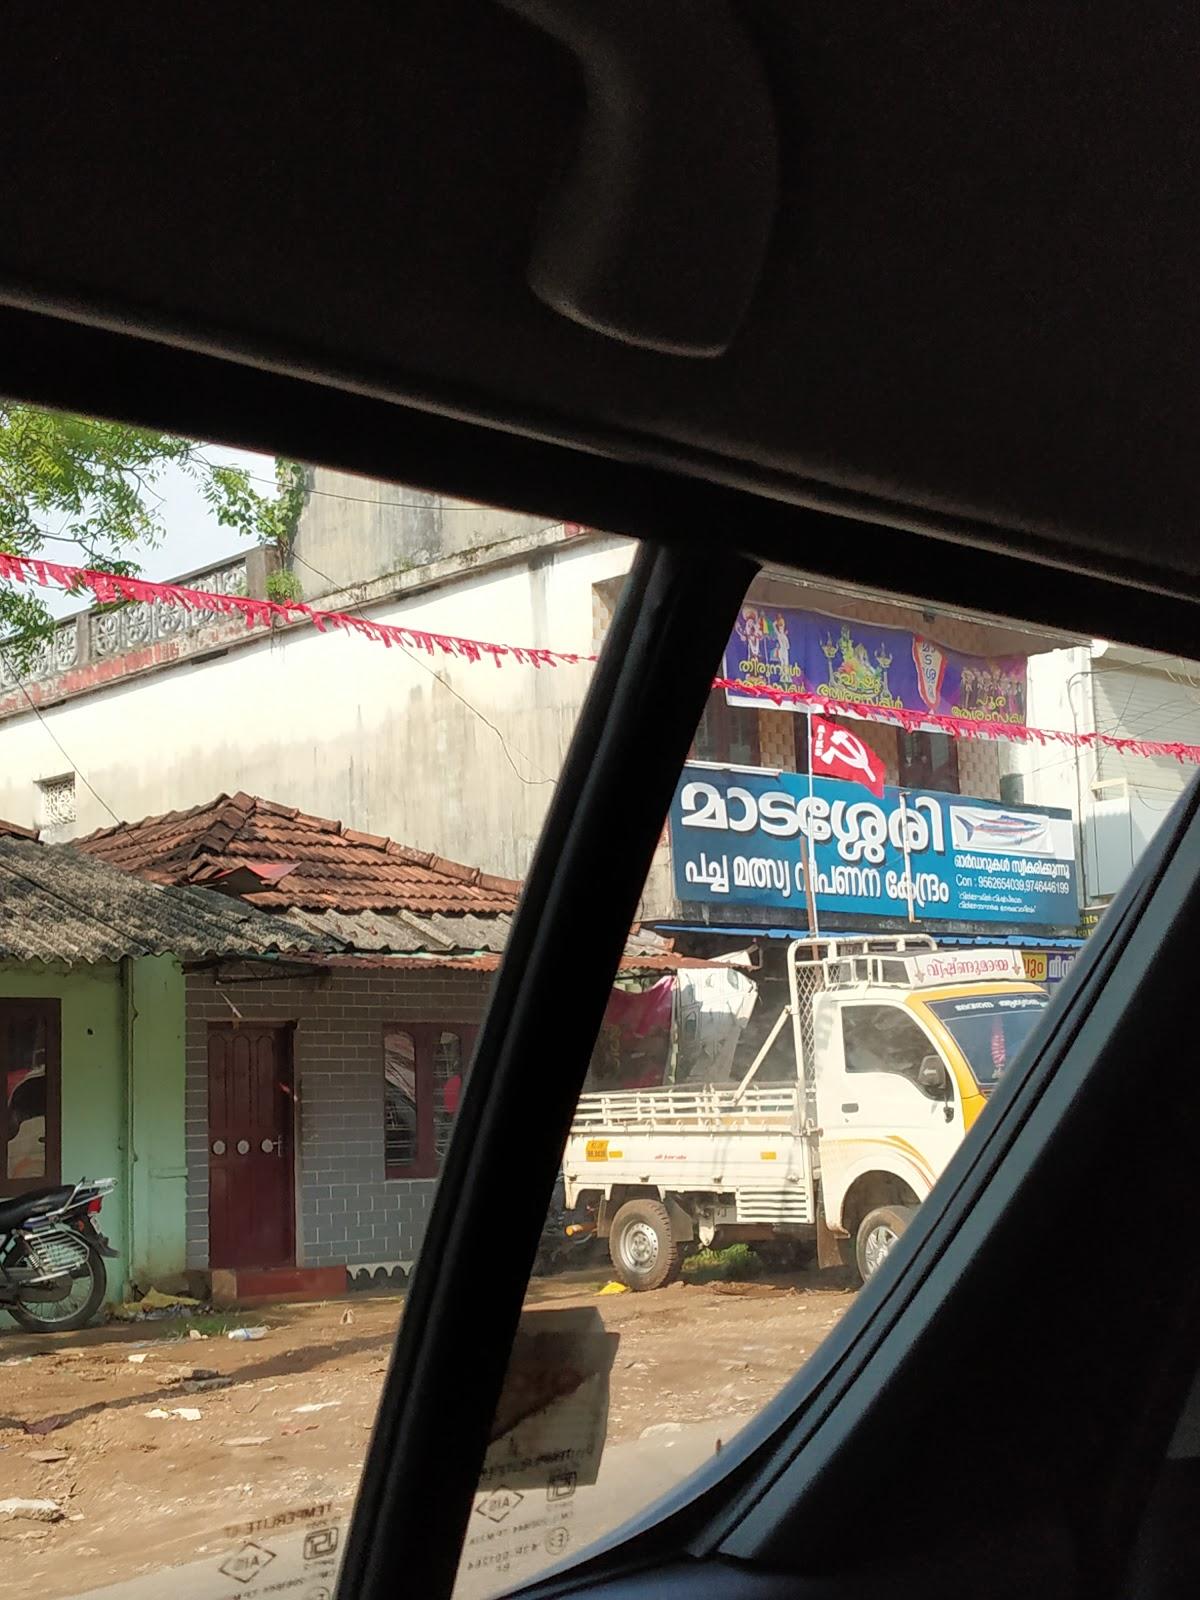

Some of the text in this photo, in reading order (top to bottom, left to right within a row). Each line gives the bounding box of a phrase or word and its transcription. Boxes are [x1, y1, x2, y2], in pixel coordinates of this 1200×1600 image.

[680, 781, 946, 865] മാടശ്ശേരി
[686, 852, 730, 894] പച്ച
[733, 856, 792, 897] മത്സ്യ
[955, 874, 972, 887] Con
